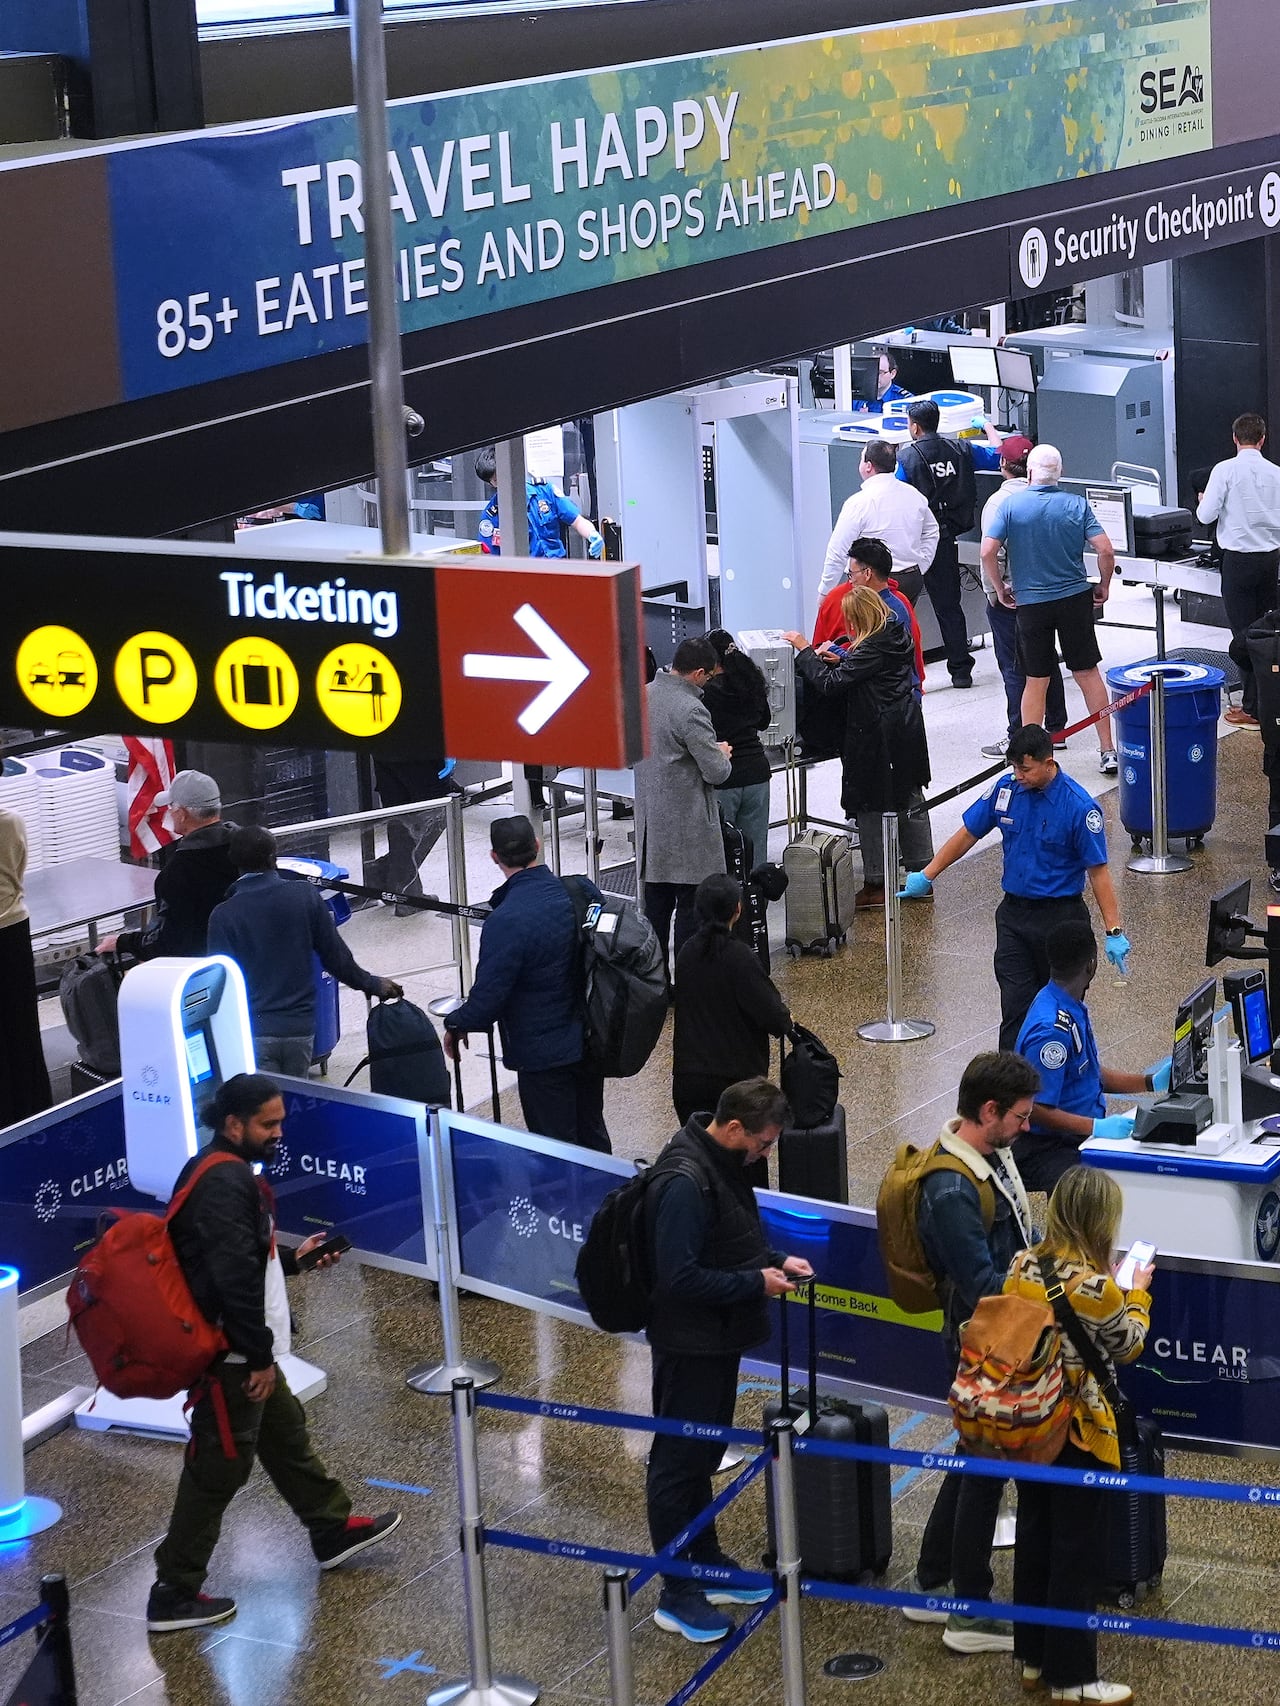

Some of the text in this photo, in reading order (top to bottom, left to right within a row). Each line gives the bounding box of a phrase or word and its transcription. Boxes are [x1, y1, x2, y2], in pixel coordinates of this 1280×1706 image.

[1140, 65, 1202, 113] SEA
[1140, 119, 1204, 142] DINING RETAIL
[282, 91, 740, 245] TRAVEL HAPPY
[1053, 182, 1276, 267] Security Checkpoint 5
[156, 162, 837, 358] 85+ EATEIES AND SHOPS AHEAD
[929, 460, 957, 478] TSA
[219, 571, 399, 638] Ticketing
[139, 646, 175, 705] P
[306, 875, 323, 887] SEA
[381, 891, 398, 902] SEA
[457, 906, 475, 918] SEA
[132, 1090, 171, 1105] CLEAR
[70, 1157, 129, 1198] CLEAR
[301, 1154, 366, 1185] CLEAR
[344, 1182, 367, 1196] PLUS
[548, 1216, 584, 1243] CLE
[794, 1287, 879, 1314] Wecome Back
[1153, 1338, 1248, 1368] CLEAR
[1218, 1367, 1248, 1380] PLUS
[1151, 1407, 1197, 1419] clearme.com
[696, 1428, 722, 1437] CLEAR
[937, 1460, 1128, 1486] CLEAR CLEAR
[705, 1569, 731, 1578] CLEAR
[941, 1602, 1132, 1630] CLEAR CLEAR
